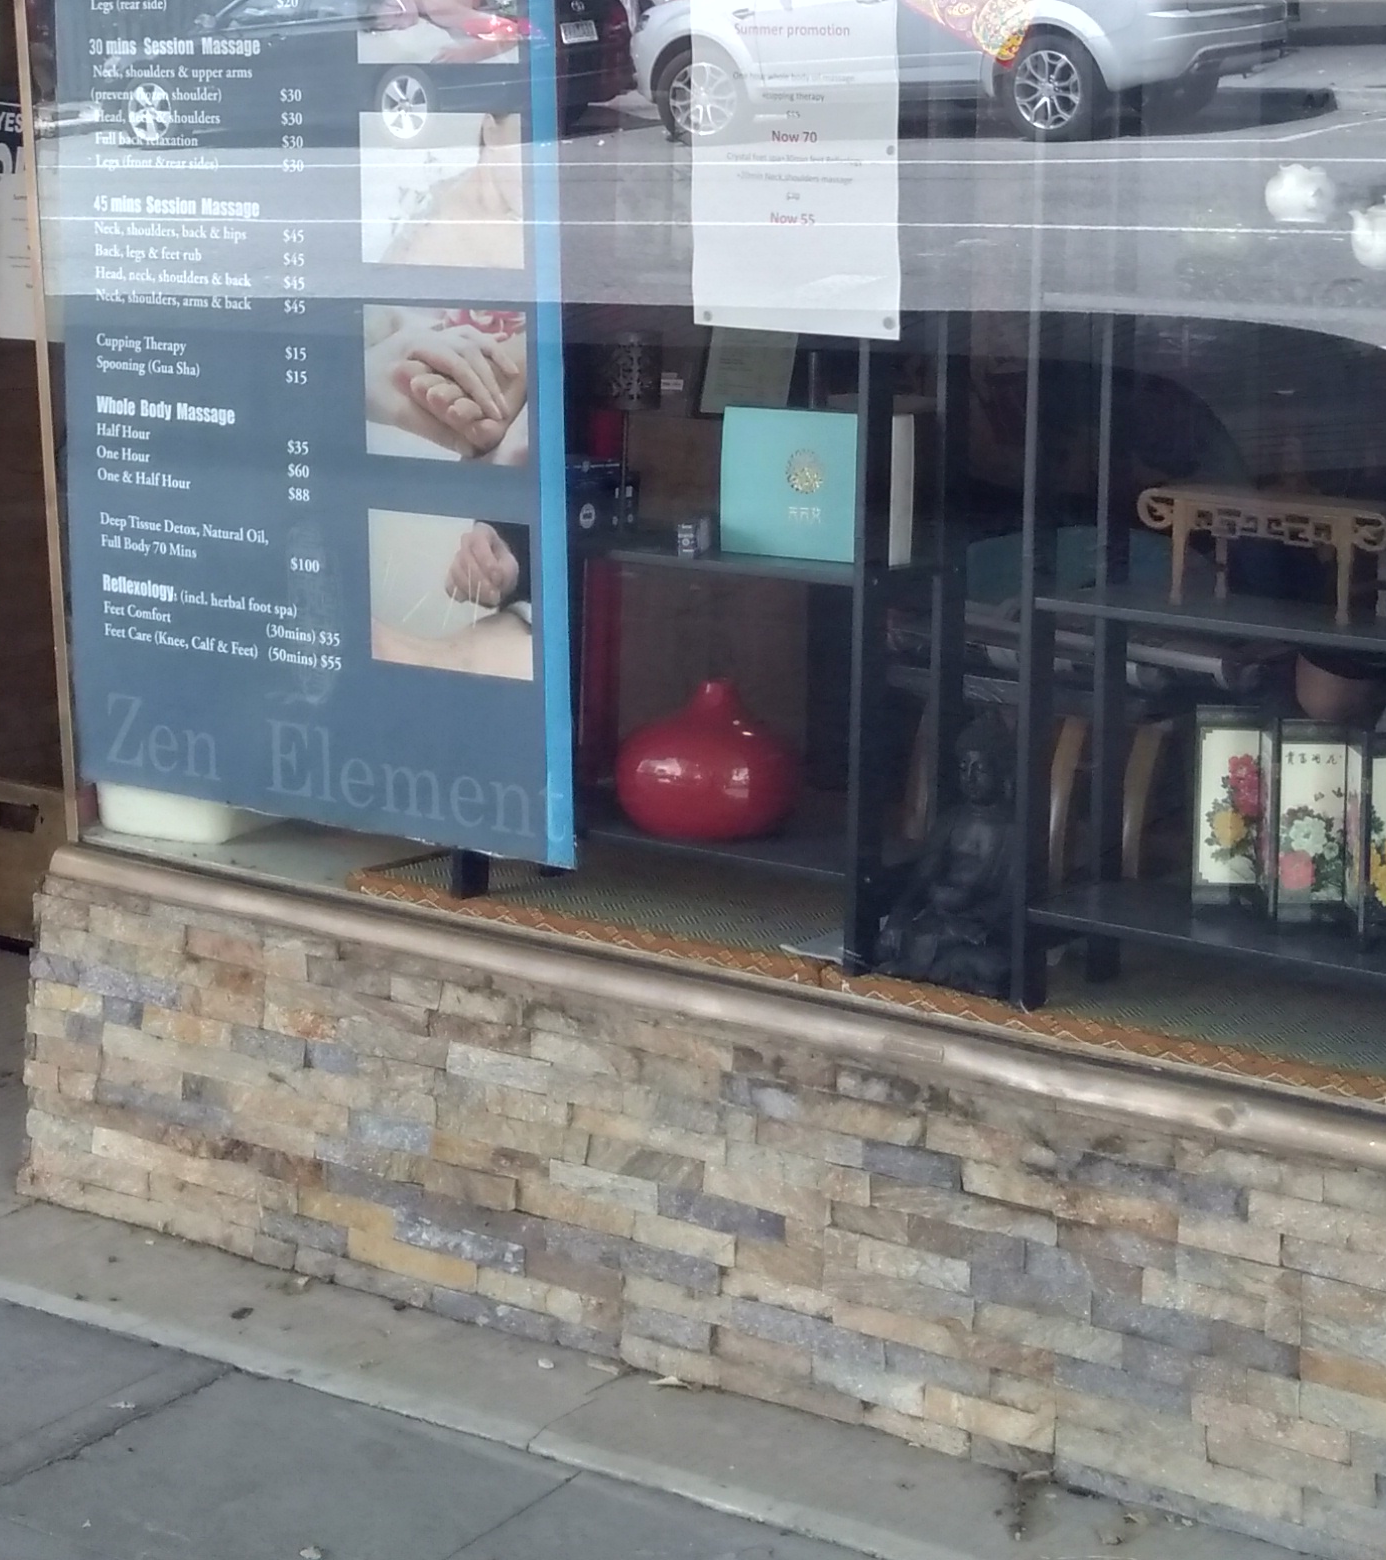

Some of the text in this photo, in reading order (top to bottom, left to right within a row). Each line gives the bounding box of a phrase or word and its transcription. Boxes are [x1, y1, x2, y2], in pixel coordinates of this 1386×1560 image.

[734, 23, 850, 37] Summer promotion
[89, 37, 260, 56] 30 mins Session Massage
[126, 64, 252, 82] shoulders upper arms
[172, 88, 222, 103] shoulder)
[280, 89, 302, 102] $30
[796, 94, 824, 102] therapy
[169, 111, 221, 124] shoulders
[281, 112, 303, 125] $30
[95, 133, 116, 145] Full
[282, 136, 303, 149] $30
[772, 130, 817, 143] Now 70
[283, 159, 304, 172] $30
[94, 195, 260, 219] 45 mins Session Massage
[770, 212, 815, 224] Now 55
[182, 225, 247, 244] back hips
[283, 229, 304, 243] $45
[126, 245, 145, 262] legs
[162, 247, 180, 260] feet
[183, 249, 202, 261] rub
[283, 253, 304, 267] $45
[158, 270, 251, 287] shoulders back
[284, 277, 305, 291] $45
[183, 296, 251, 310] arms back
[284, 300, 306, 314] $45
[96, 333, 186, 356] Cupping Therapy
[285, 346, 307, 361] $15
[96, 356, 200, 378] Spooning (Gua Sha)
[286, 370, 308, 385] $15
[96, 395, 235, 426] Whole Body Massage
[97, 423, 151, 440] Half Hour
[97, 445, 150, 463] One Hour
[287, 440, 309, 456] $35
[97, 467, 191, 490] One Half Hour
[288, 464, 309, 479] $60
[289, 487, 310, 502] $88
[100, 512, 269, 546] Deep Tissue Detox, Natural Oil,
[101, 534, 197, 559] Full Body 70 Mins
[291, 557, 320, 573] $100
[102, 574, 297, 620] Reflexology: (incl. herbal foot spa)
[104, 601, 340, 647] Feet Comfort (30mins) $35
[105, 623, 342, 671] Feet Care (Knee, Calf Feet) (50mins) $55
[106, 692, 222, 783] Zen
